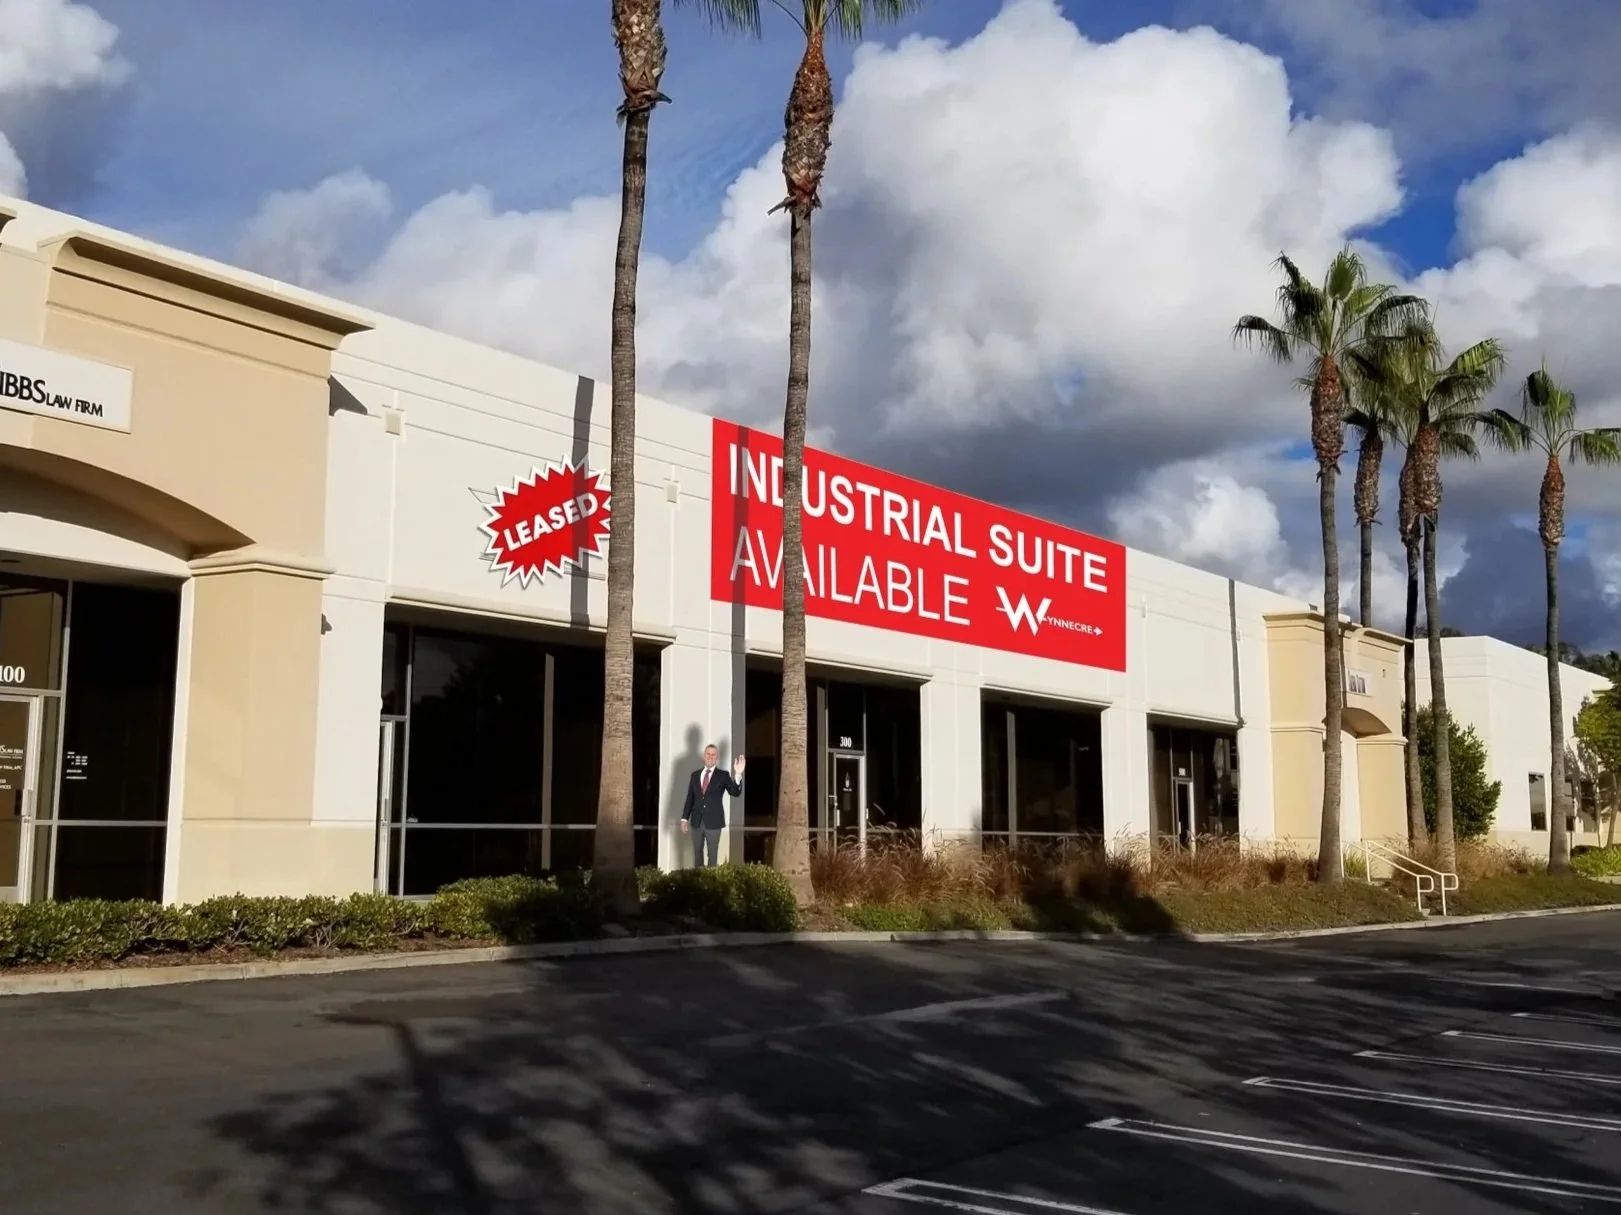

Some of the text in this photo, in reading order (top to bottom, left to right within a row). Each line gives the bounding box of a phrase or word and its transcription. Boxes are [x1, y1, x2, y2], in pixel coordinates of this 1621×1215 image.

[46, 392, 73, 410] LAW
[75, 399, 103, 417] FIRM
[503, 492, 599, 552] LEASED
[988, 524, 1108, 593] SUITE
[840, 736, 852, 748] 300
